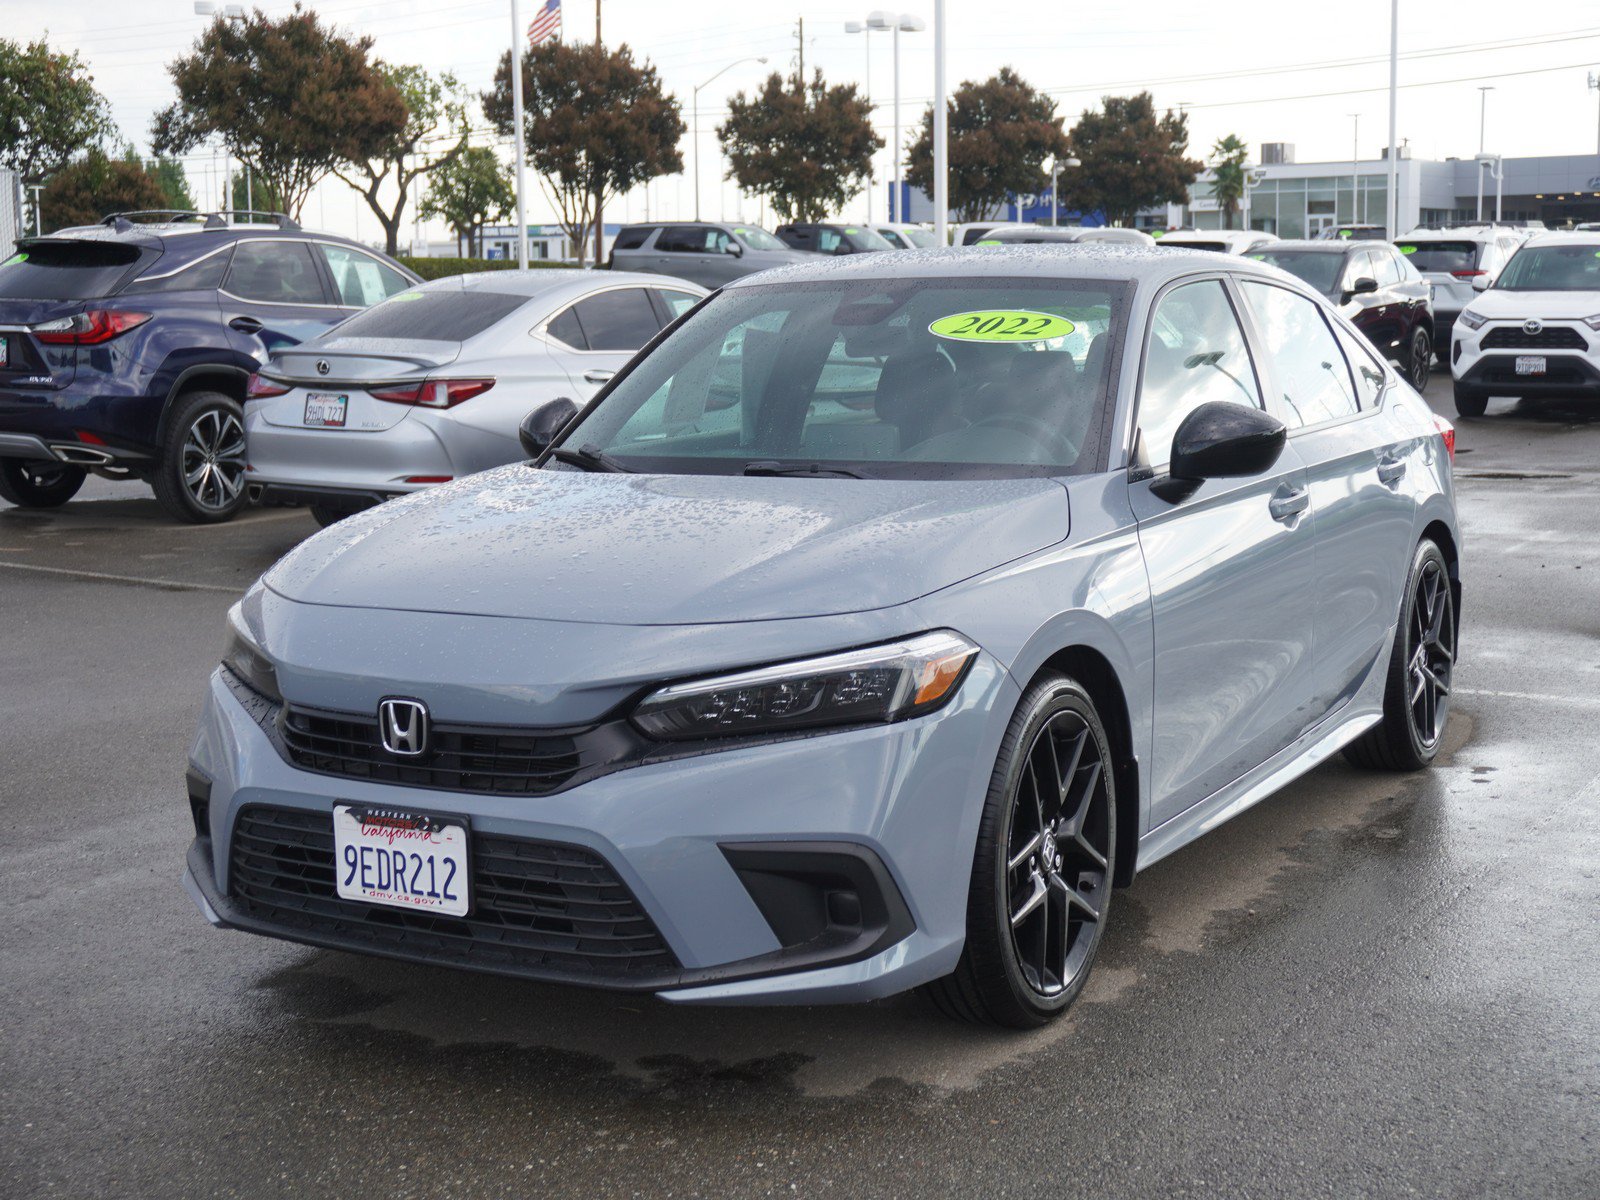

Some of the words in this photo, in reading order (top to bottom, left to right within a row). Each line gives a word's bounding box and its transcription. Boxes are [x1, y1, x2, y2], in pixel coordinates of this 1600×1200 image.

[950, 316, 1052, 336] 2022
[307, 405, 343, 421] 9HDL727
[367, 809, 411, 820] WESTERN
[365, 816, 413, 830] MOTORS
[361, 820, 441, 845] California
[344, 845, 457, 901] 9EDR212
[369, 890, 435, 905] dmv.ca.gov
